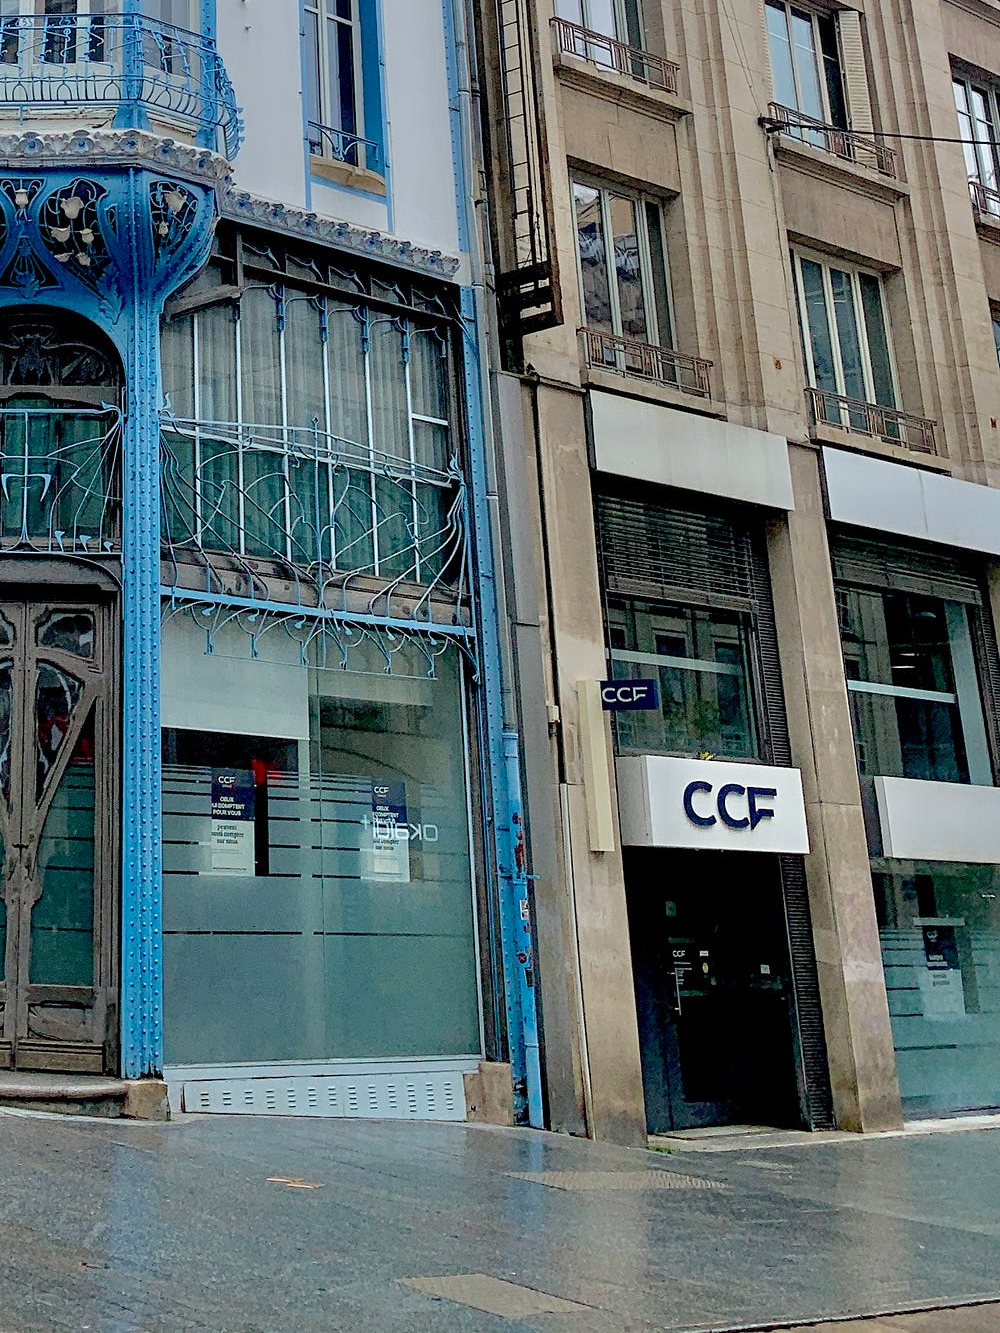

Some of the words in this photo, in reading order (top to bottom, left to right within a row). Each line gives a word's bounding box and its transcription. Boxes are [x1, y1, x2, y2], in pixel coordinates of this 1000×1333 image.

[601, 686, 648, 703] CCF
[218, 776, 236, 784] CCF
[373, 786, 389, 794] CCF
[683, 780, 777, 831] CCF
